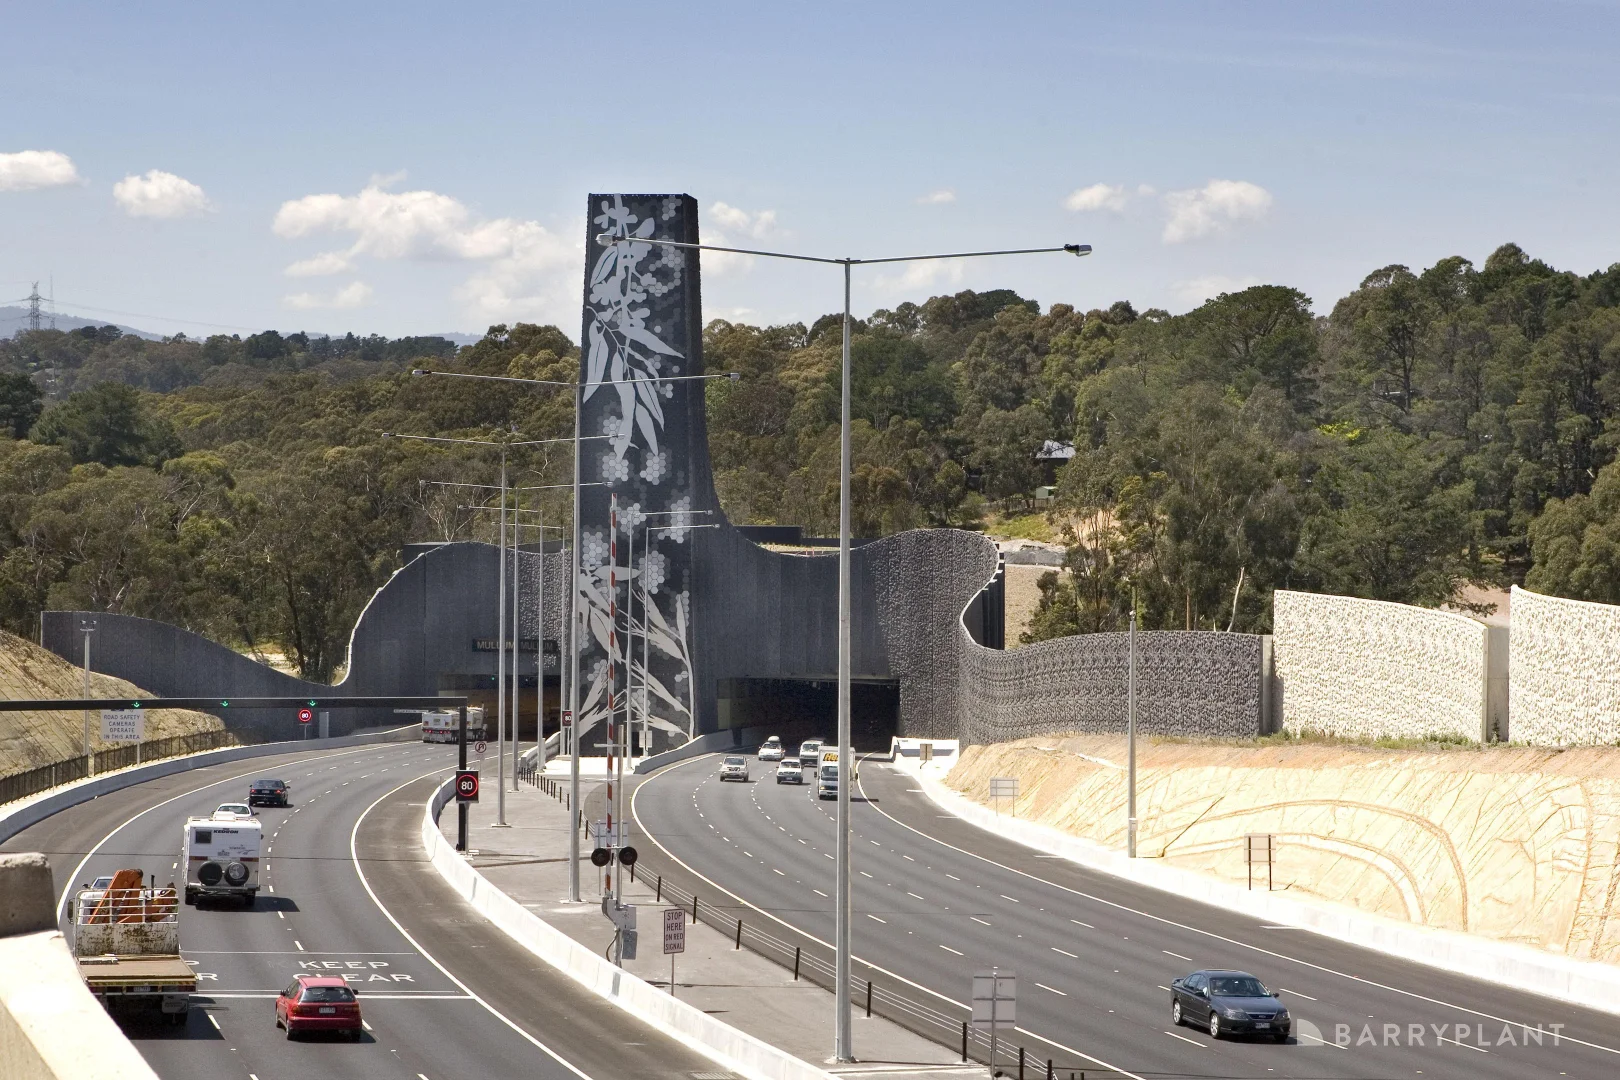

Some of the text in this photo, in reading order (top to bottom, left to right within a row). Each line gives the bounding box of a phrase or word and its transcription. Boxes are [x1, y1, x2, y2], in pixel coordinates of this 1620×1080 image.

[462, 782, 472, 790] 80
[666, 912, 682, 920] STOP
[666, 922, 682, 931] HERE
[673, 932, 684, 940] RED
[666, 942, 683, 950] SIGNAL
[298, 960, 390, 968] KEEP
